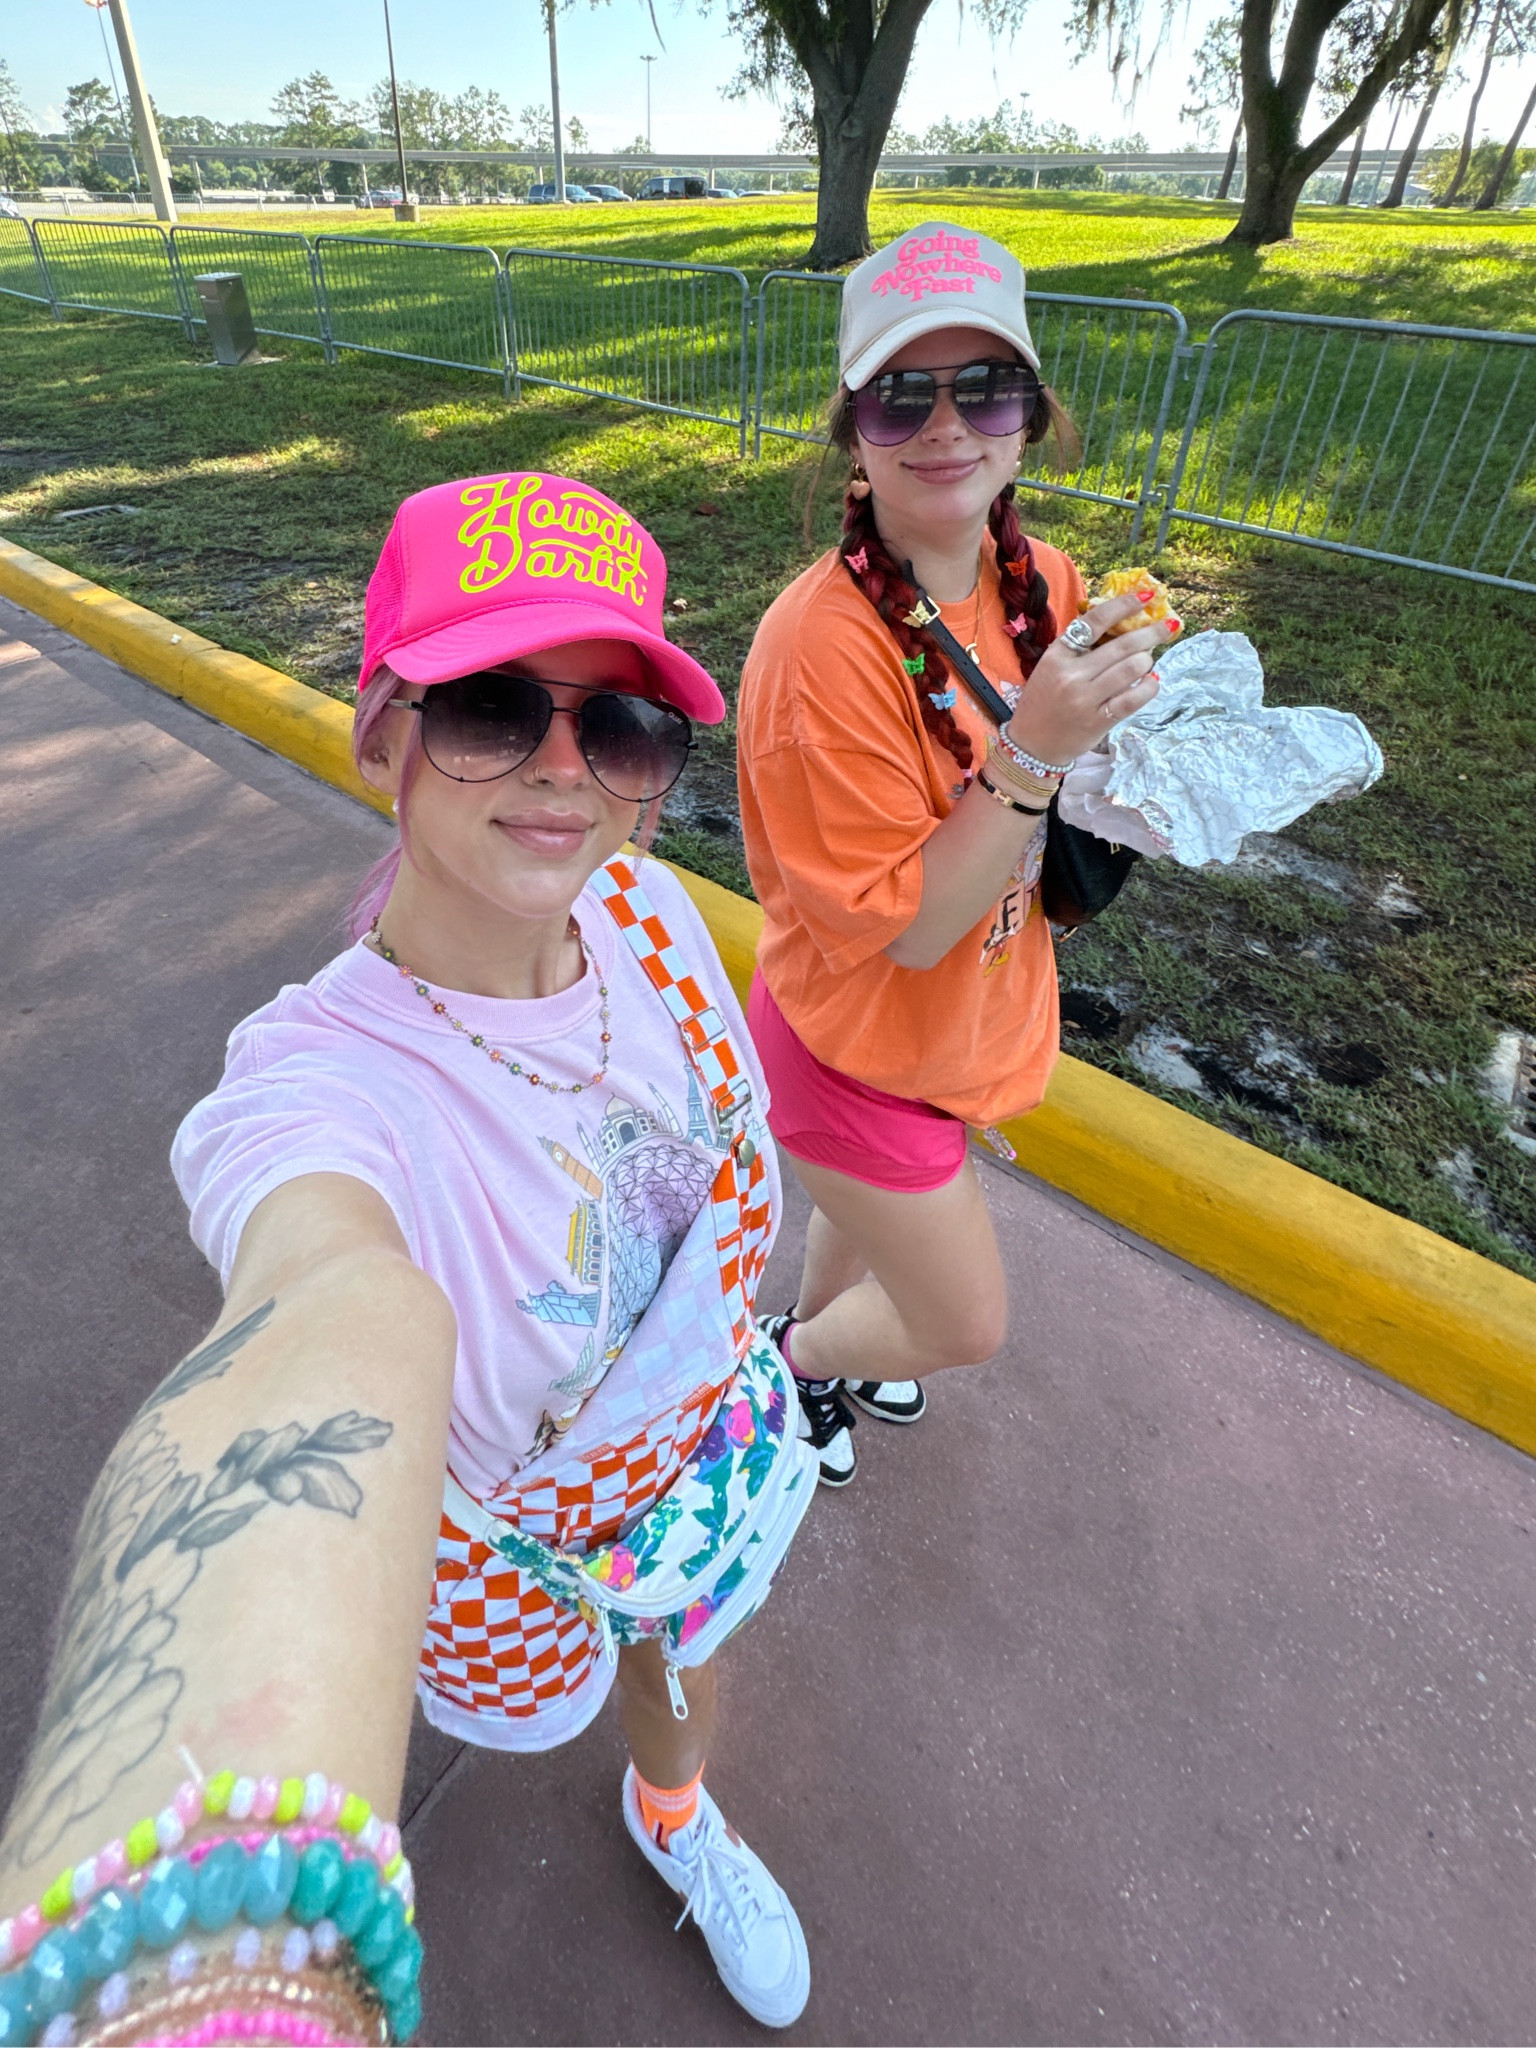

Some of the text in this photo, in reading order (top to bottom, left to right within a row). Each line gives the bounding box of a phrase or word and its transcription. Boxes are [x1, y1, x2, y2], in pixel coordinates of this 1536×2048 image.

[897, 229, 981, 267] Going
[870, 251, 1003, 298] Nowhere
[900, 275, 976, 302] Fast
[458, 476, 648, 580] Howdy
